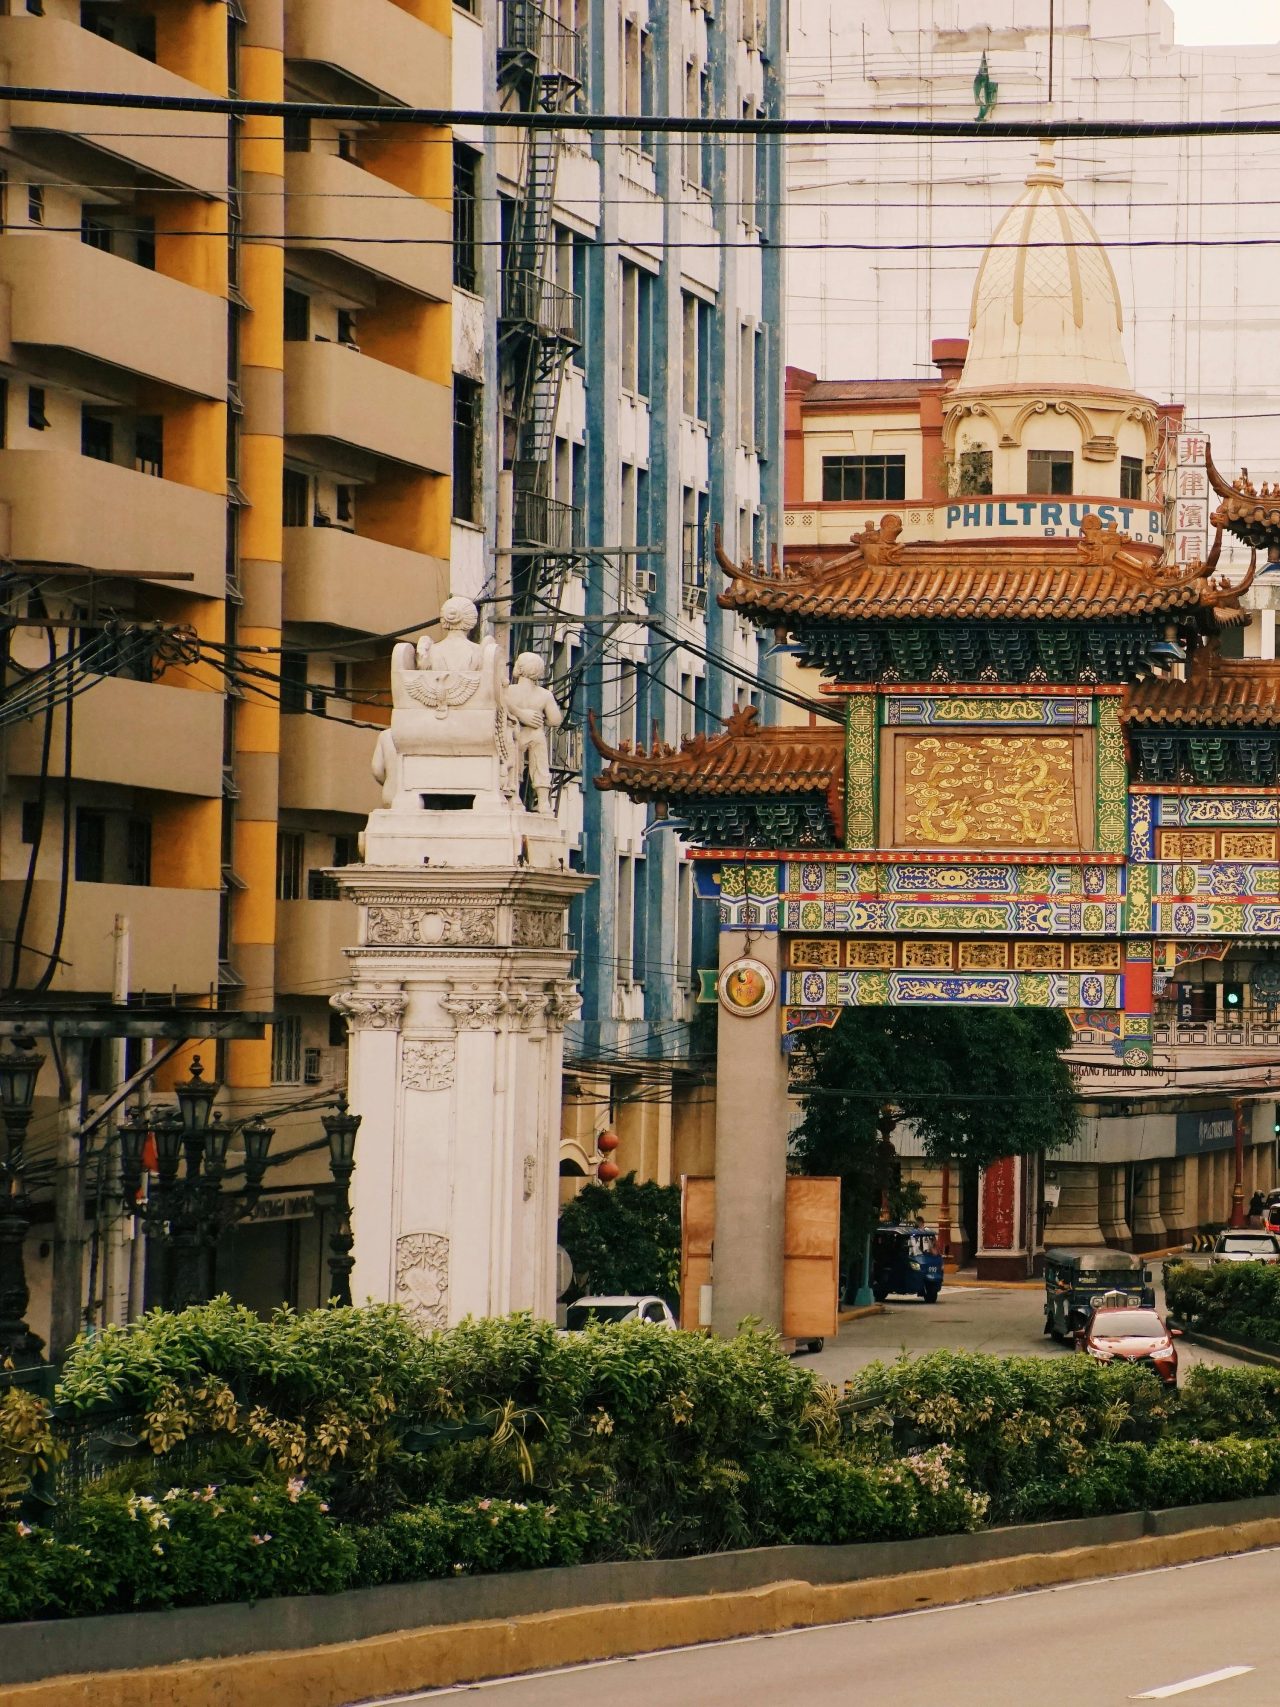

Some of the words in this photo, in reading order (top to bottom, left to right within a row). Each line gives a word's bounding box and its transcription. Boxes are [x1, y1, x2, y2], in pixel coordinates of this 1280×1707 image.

[947, 503, 1134, 529] PHILTRUST
[1149, 511, 1163, 535] B
[1178, 437, 1205, 561] 菲律濱信
